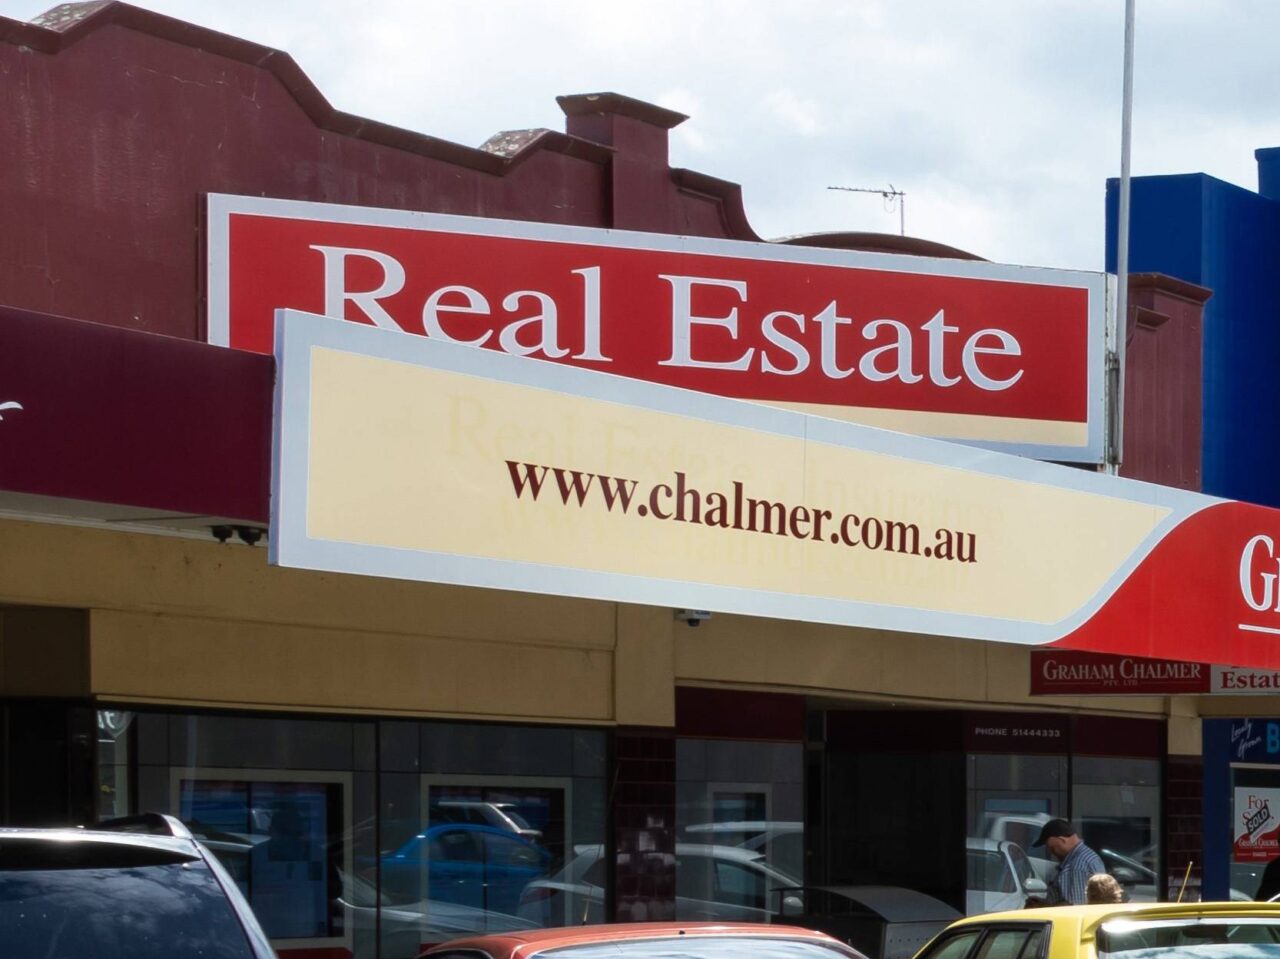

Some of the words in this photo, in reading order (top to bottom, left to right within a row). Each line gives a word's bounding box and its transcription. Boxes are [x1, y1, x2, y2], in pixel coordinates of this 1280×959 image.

[309, 244, 612, 362] Real
[658, 273, 1024, 391] Estate
[505, 459, 978, 563] www.chalmer.com.au
[1042, 659, 1115, 681] GRAHAM
[1119, 658, 1201, 680] CHALMER
[975, 727, 1008, 736] PHONE
[1248, 795, 1270, 810] For
[1247, 808, 1268, 832] SOLD
